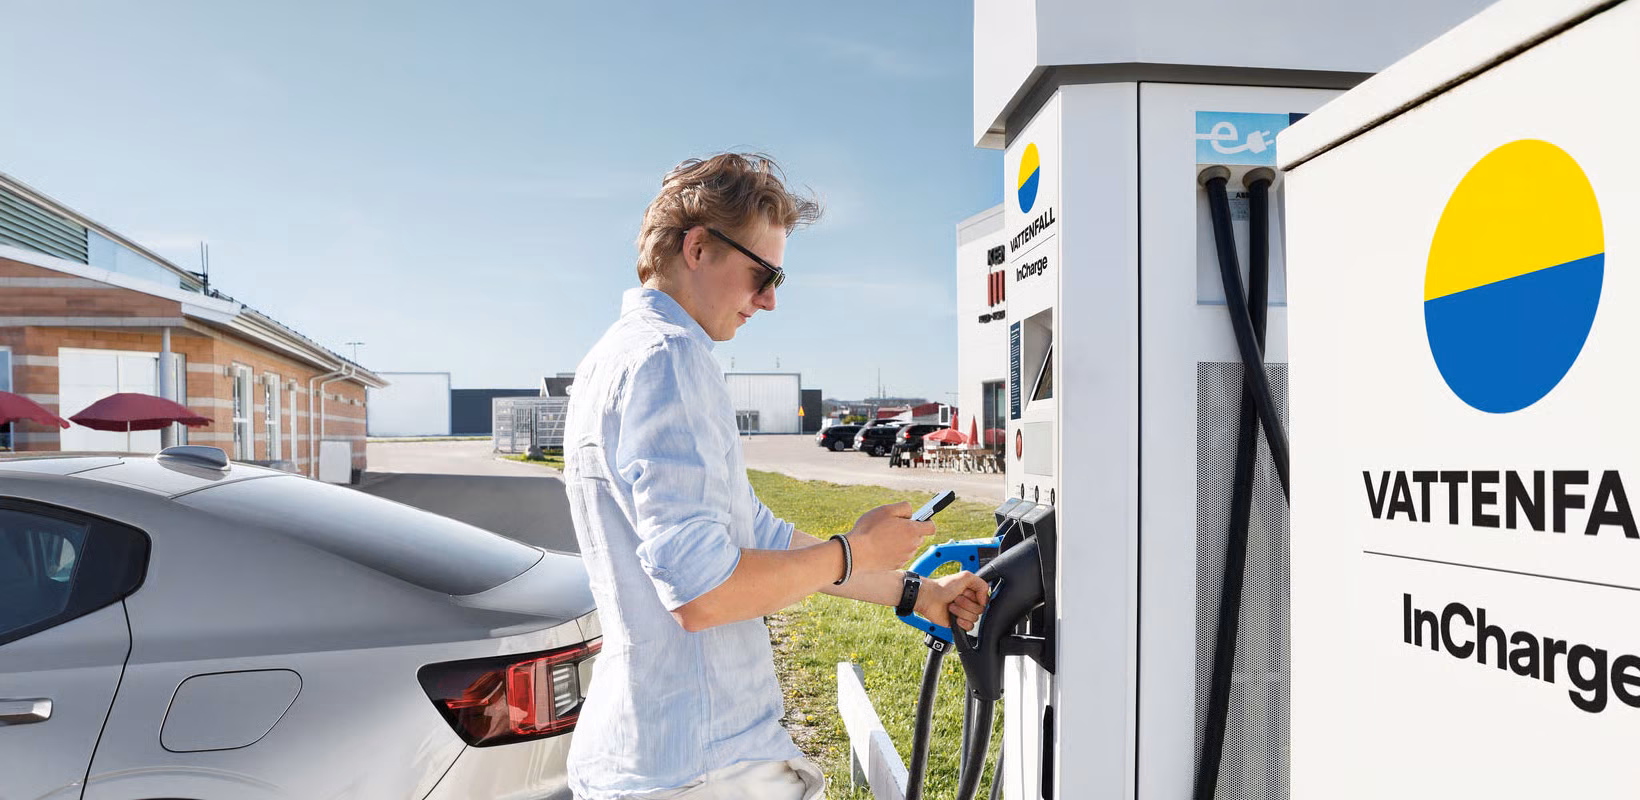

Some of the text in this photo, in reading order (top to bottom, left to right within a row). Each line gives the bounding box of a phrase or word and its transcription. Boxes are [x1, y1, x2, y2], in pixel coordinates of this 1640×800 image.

[1010, 207, 1056, 253] VATTENFALL
[1016, 256, 1048, 282] InCharge
[1403, 593, 1640, 713] InCharge
